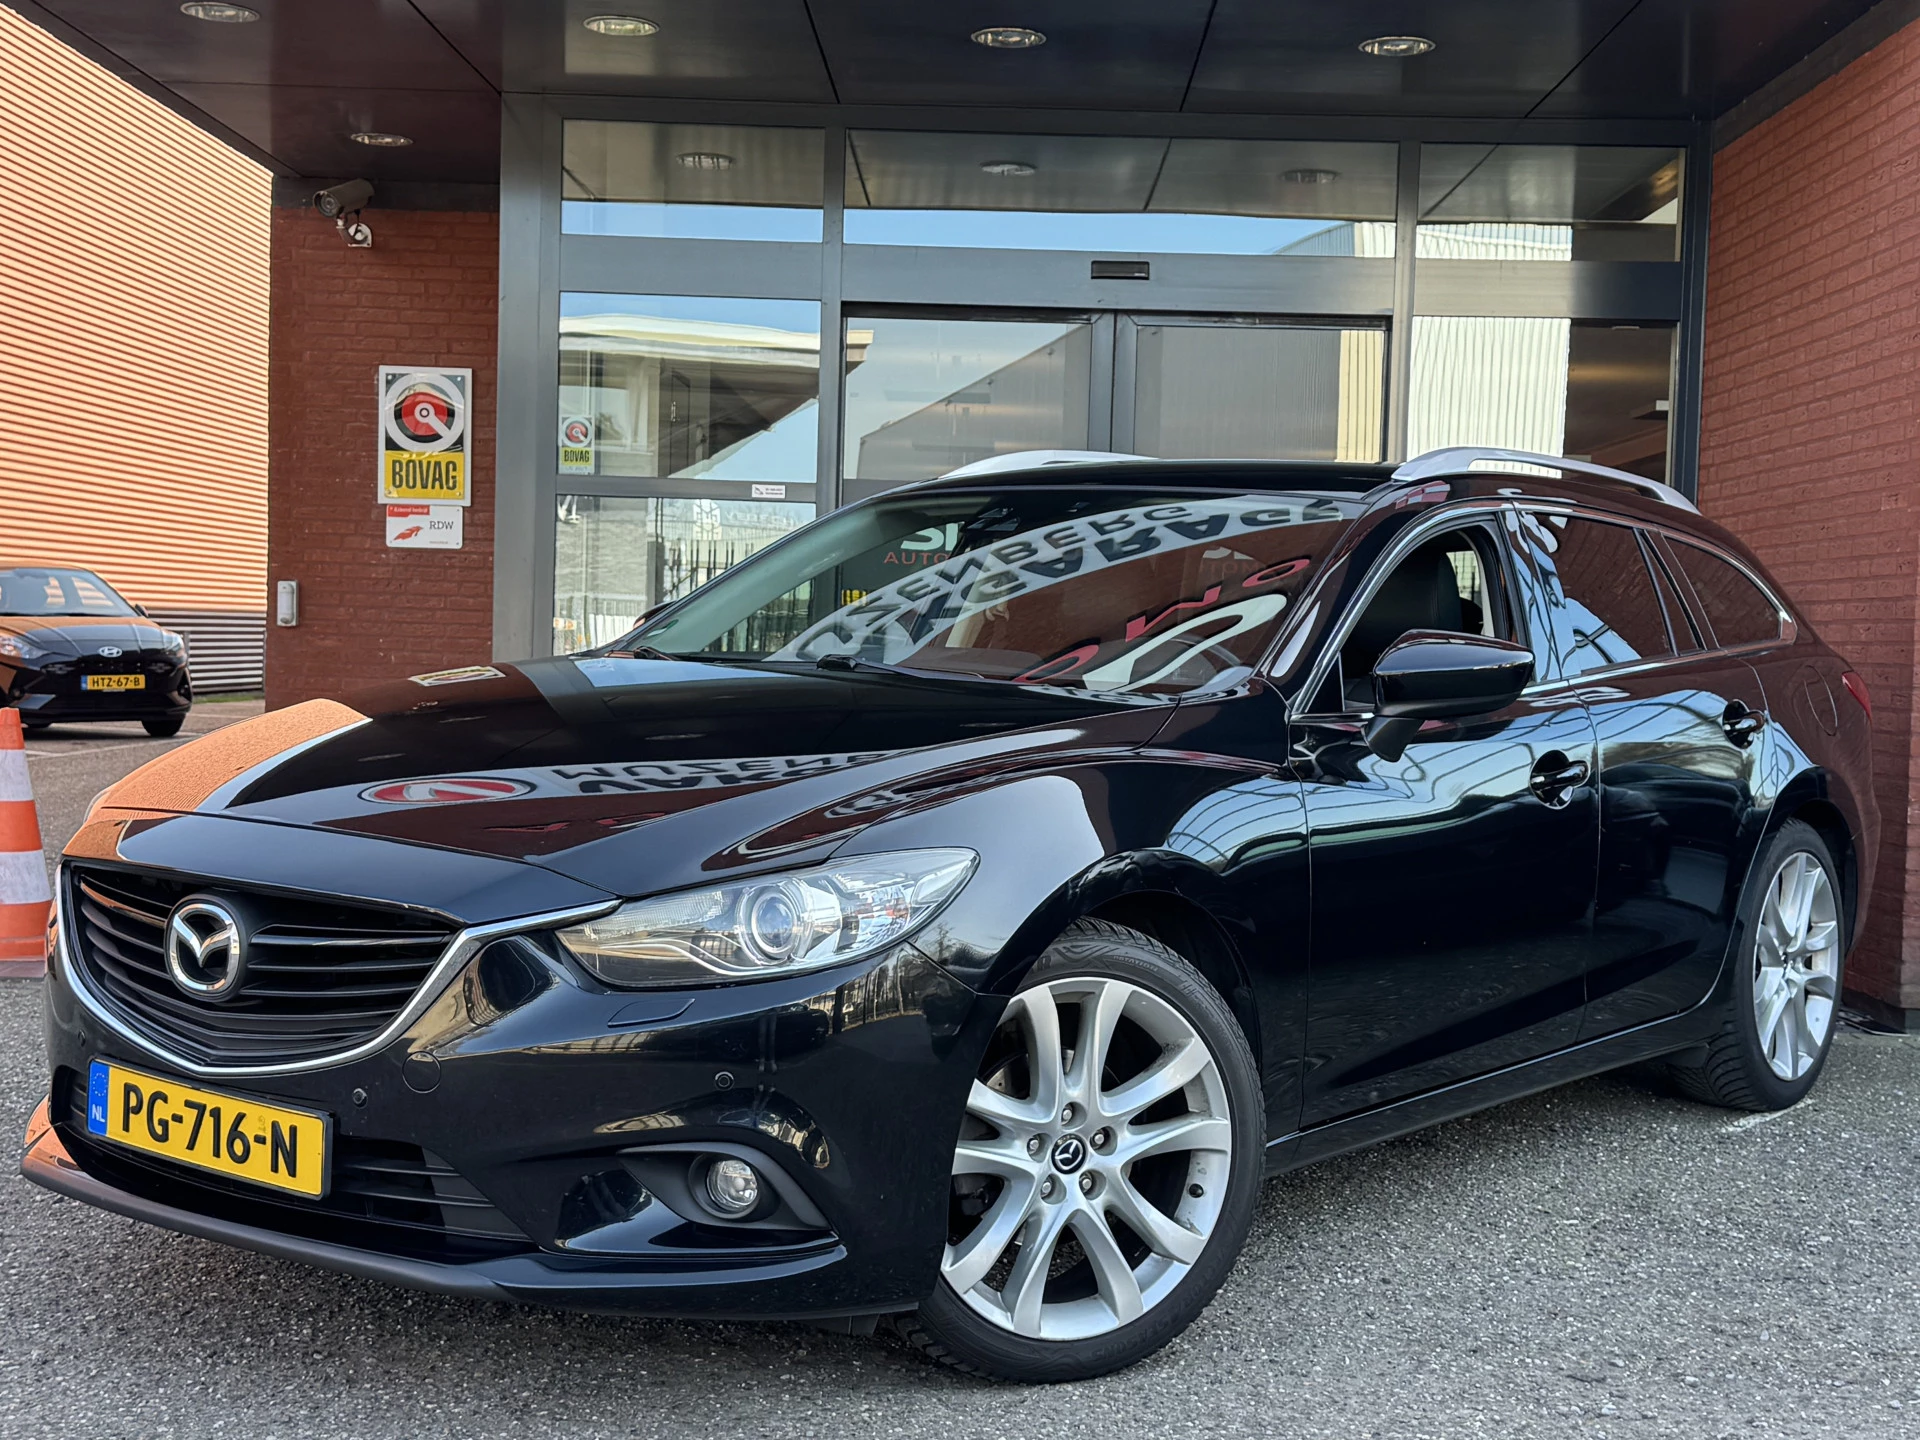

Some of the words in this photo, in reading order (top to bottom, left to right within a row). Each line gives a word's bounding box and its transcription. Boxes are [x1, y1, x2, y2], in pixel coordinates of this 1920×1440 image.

[564, 449, 590, 463] BOVAG
[391, 459, 457, 491] BOVAG
[429, 520, 454, 530] RDW
[92, 677, 141, 687] HTZ-67-B
[91, 1103, 105, 1122] NL
[122, 1082, 298, 1178] PG-716-N
